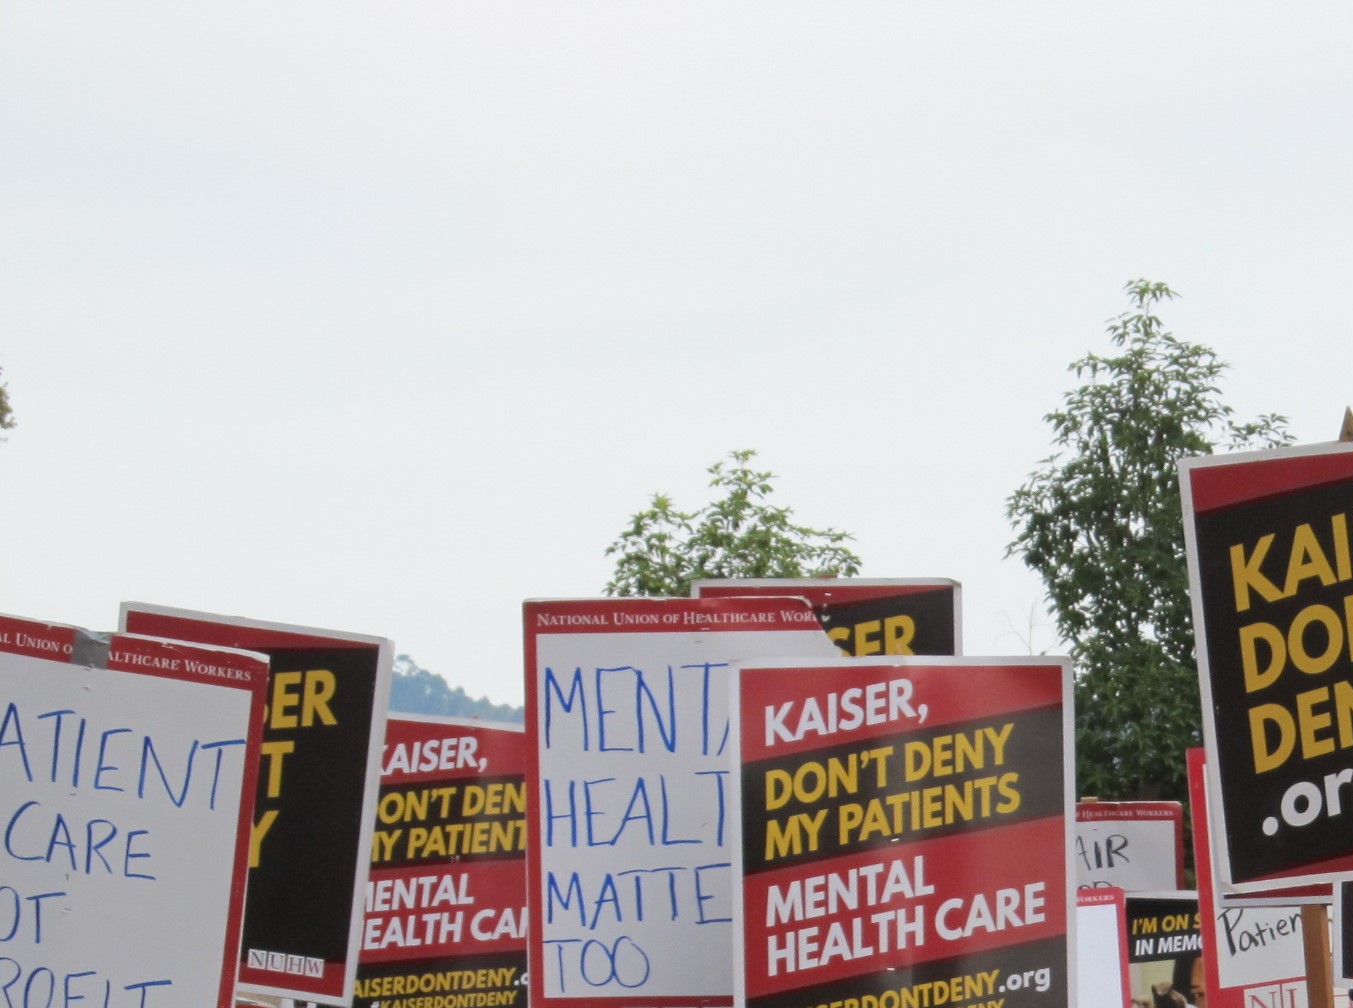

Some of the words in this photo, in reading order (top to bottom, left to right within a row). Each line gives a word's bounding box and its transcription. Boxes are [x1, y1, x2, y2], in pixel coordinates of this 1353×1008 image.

[545, 663, 729, 755] MENT
[765, 678, 928, 746] KAISER,
[0, 702, 246, 810] ATIENT
[766, 746, 893, 811] DON'T
[904, 723, 1014, 782] DENY
[378, 787, 456, 823] ON'T
[462, 783, 526, 817] DEN
[545, 771, 729, 847] HEALT
[765, 809, 828, 860] MY
[839, 772, 1021, 845] PATIENTS
[5, 801, 156, 880] CARE
[407, 819, 526, 859] PATIENT
[1076, 834, 1130, 870] AIR
[0, 886, 67, 944] OT
[548, 863, 732, 929] MATTE
[766, 855, 935, 927] MENTAL
[1162, 914, 1189, 932] ON
[362, 911, 464, 950] EALTH
[768, 905, 924, 977] HEALTH
[934, 881, 1045, 940] CARE
[1135, 939, 1154, 956] IN
[248, 949, 325, 978] NUHW
[543, 936, 650, 992] TOO
